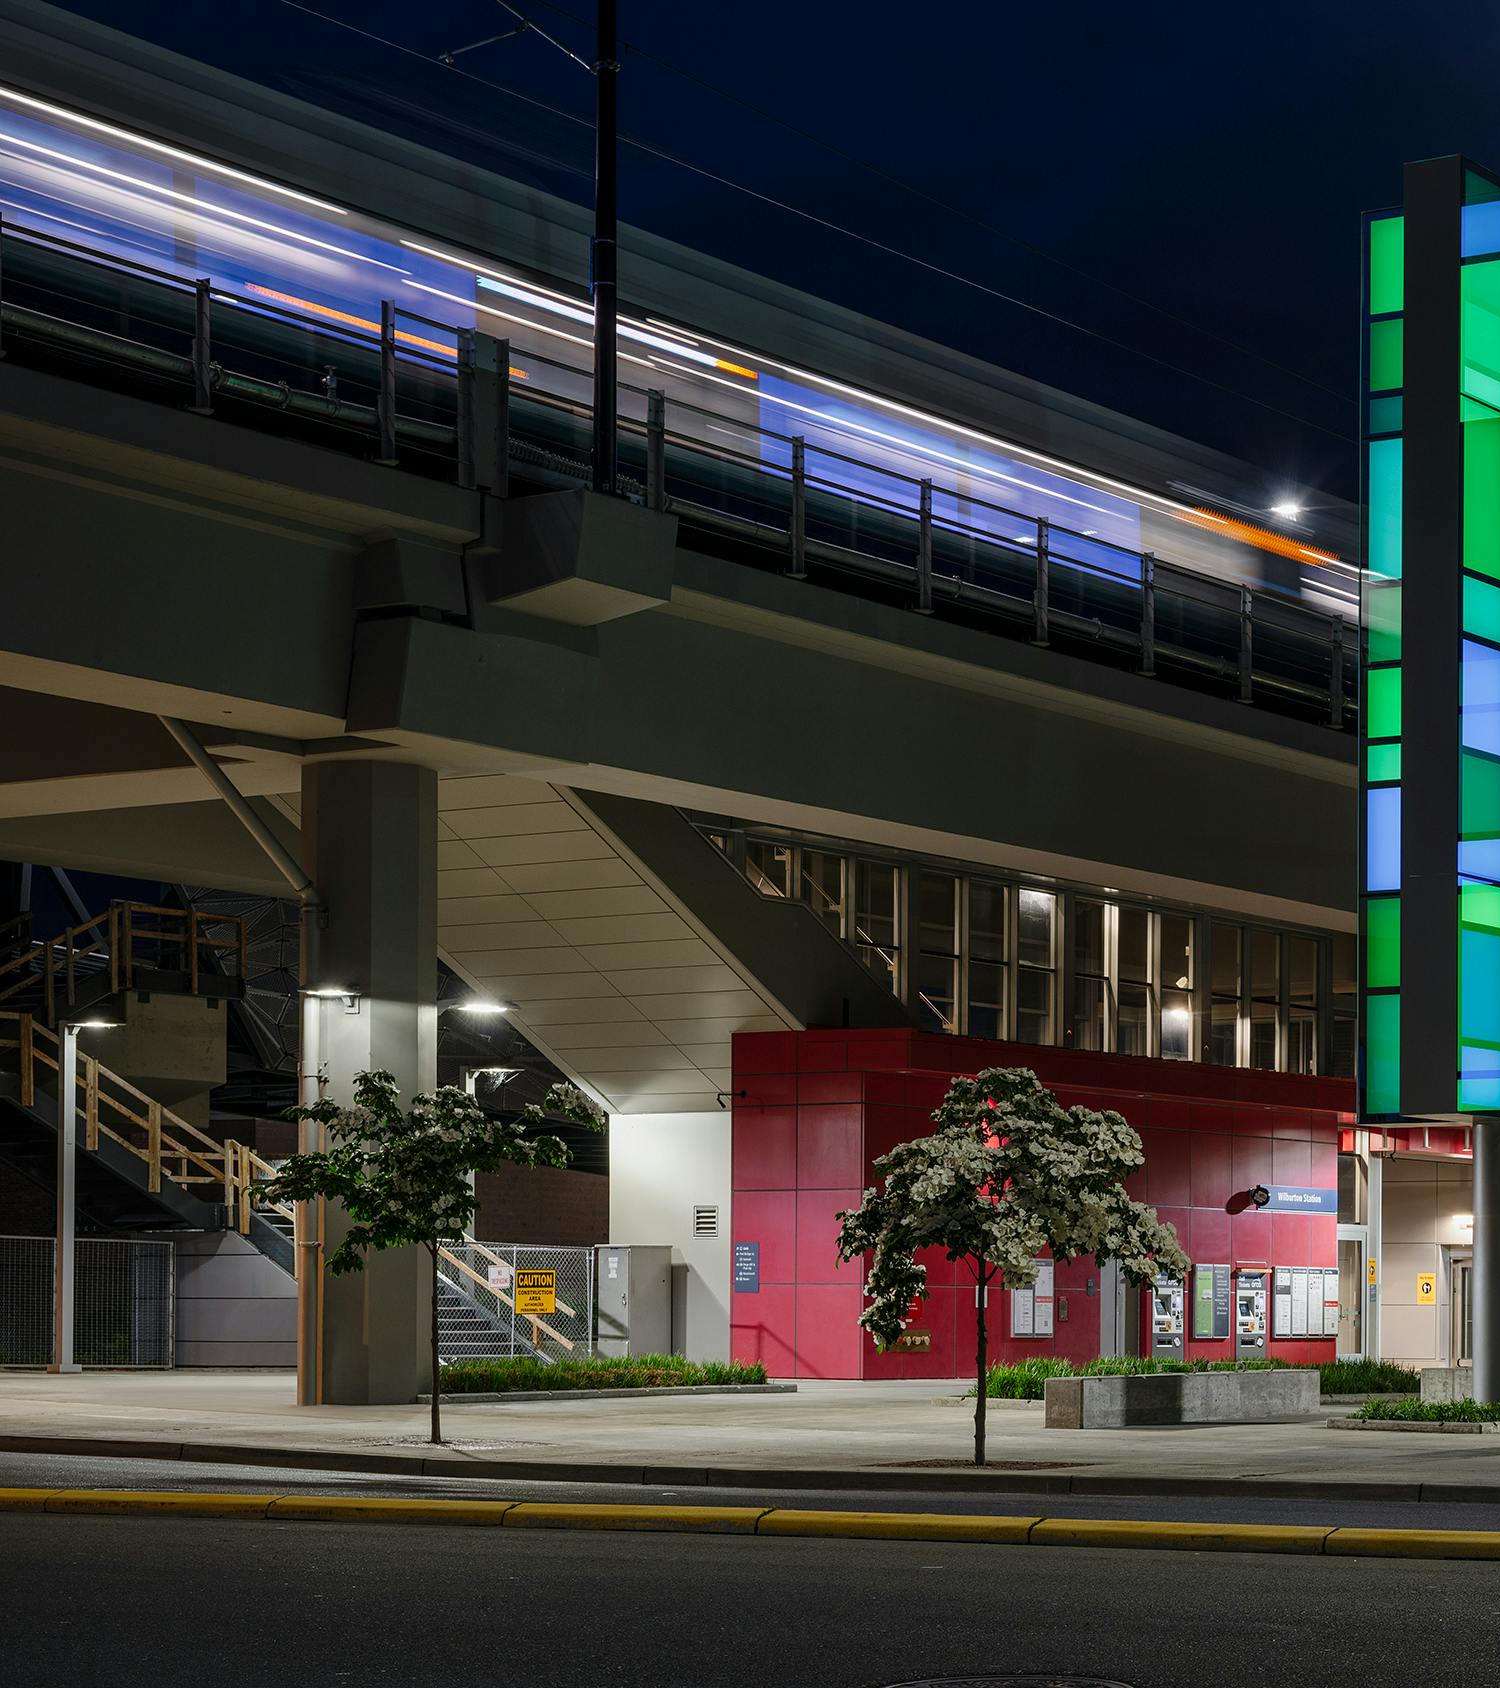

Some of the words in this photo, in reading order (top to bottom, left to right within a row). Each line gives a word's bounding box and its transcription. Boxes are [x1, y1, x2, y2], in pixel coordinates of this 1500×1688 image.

[1277, 1191, 1303, 1202] Wilburton
[1303, 1193, 1322, 1204] Station
[518, 1274, 553, 1286] CAUTION
